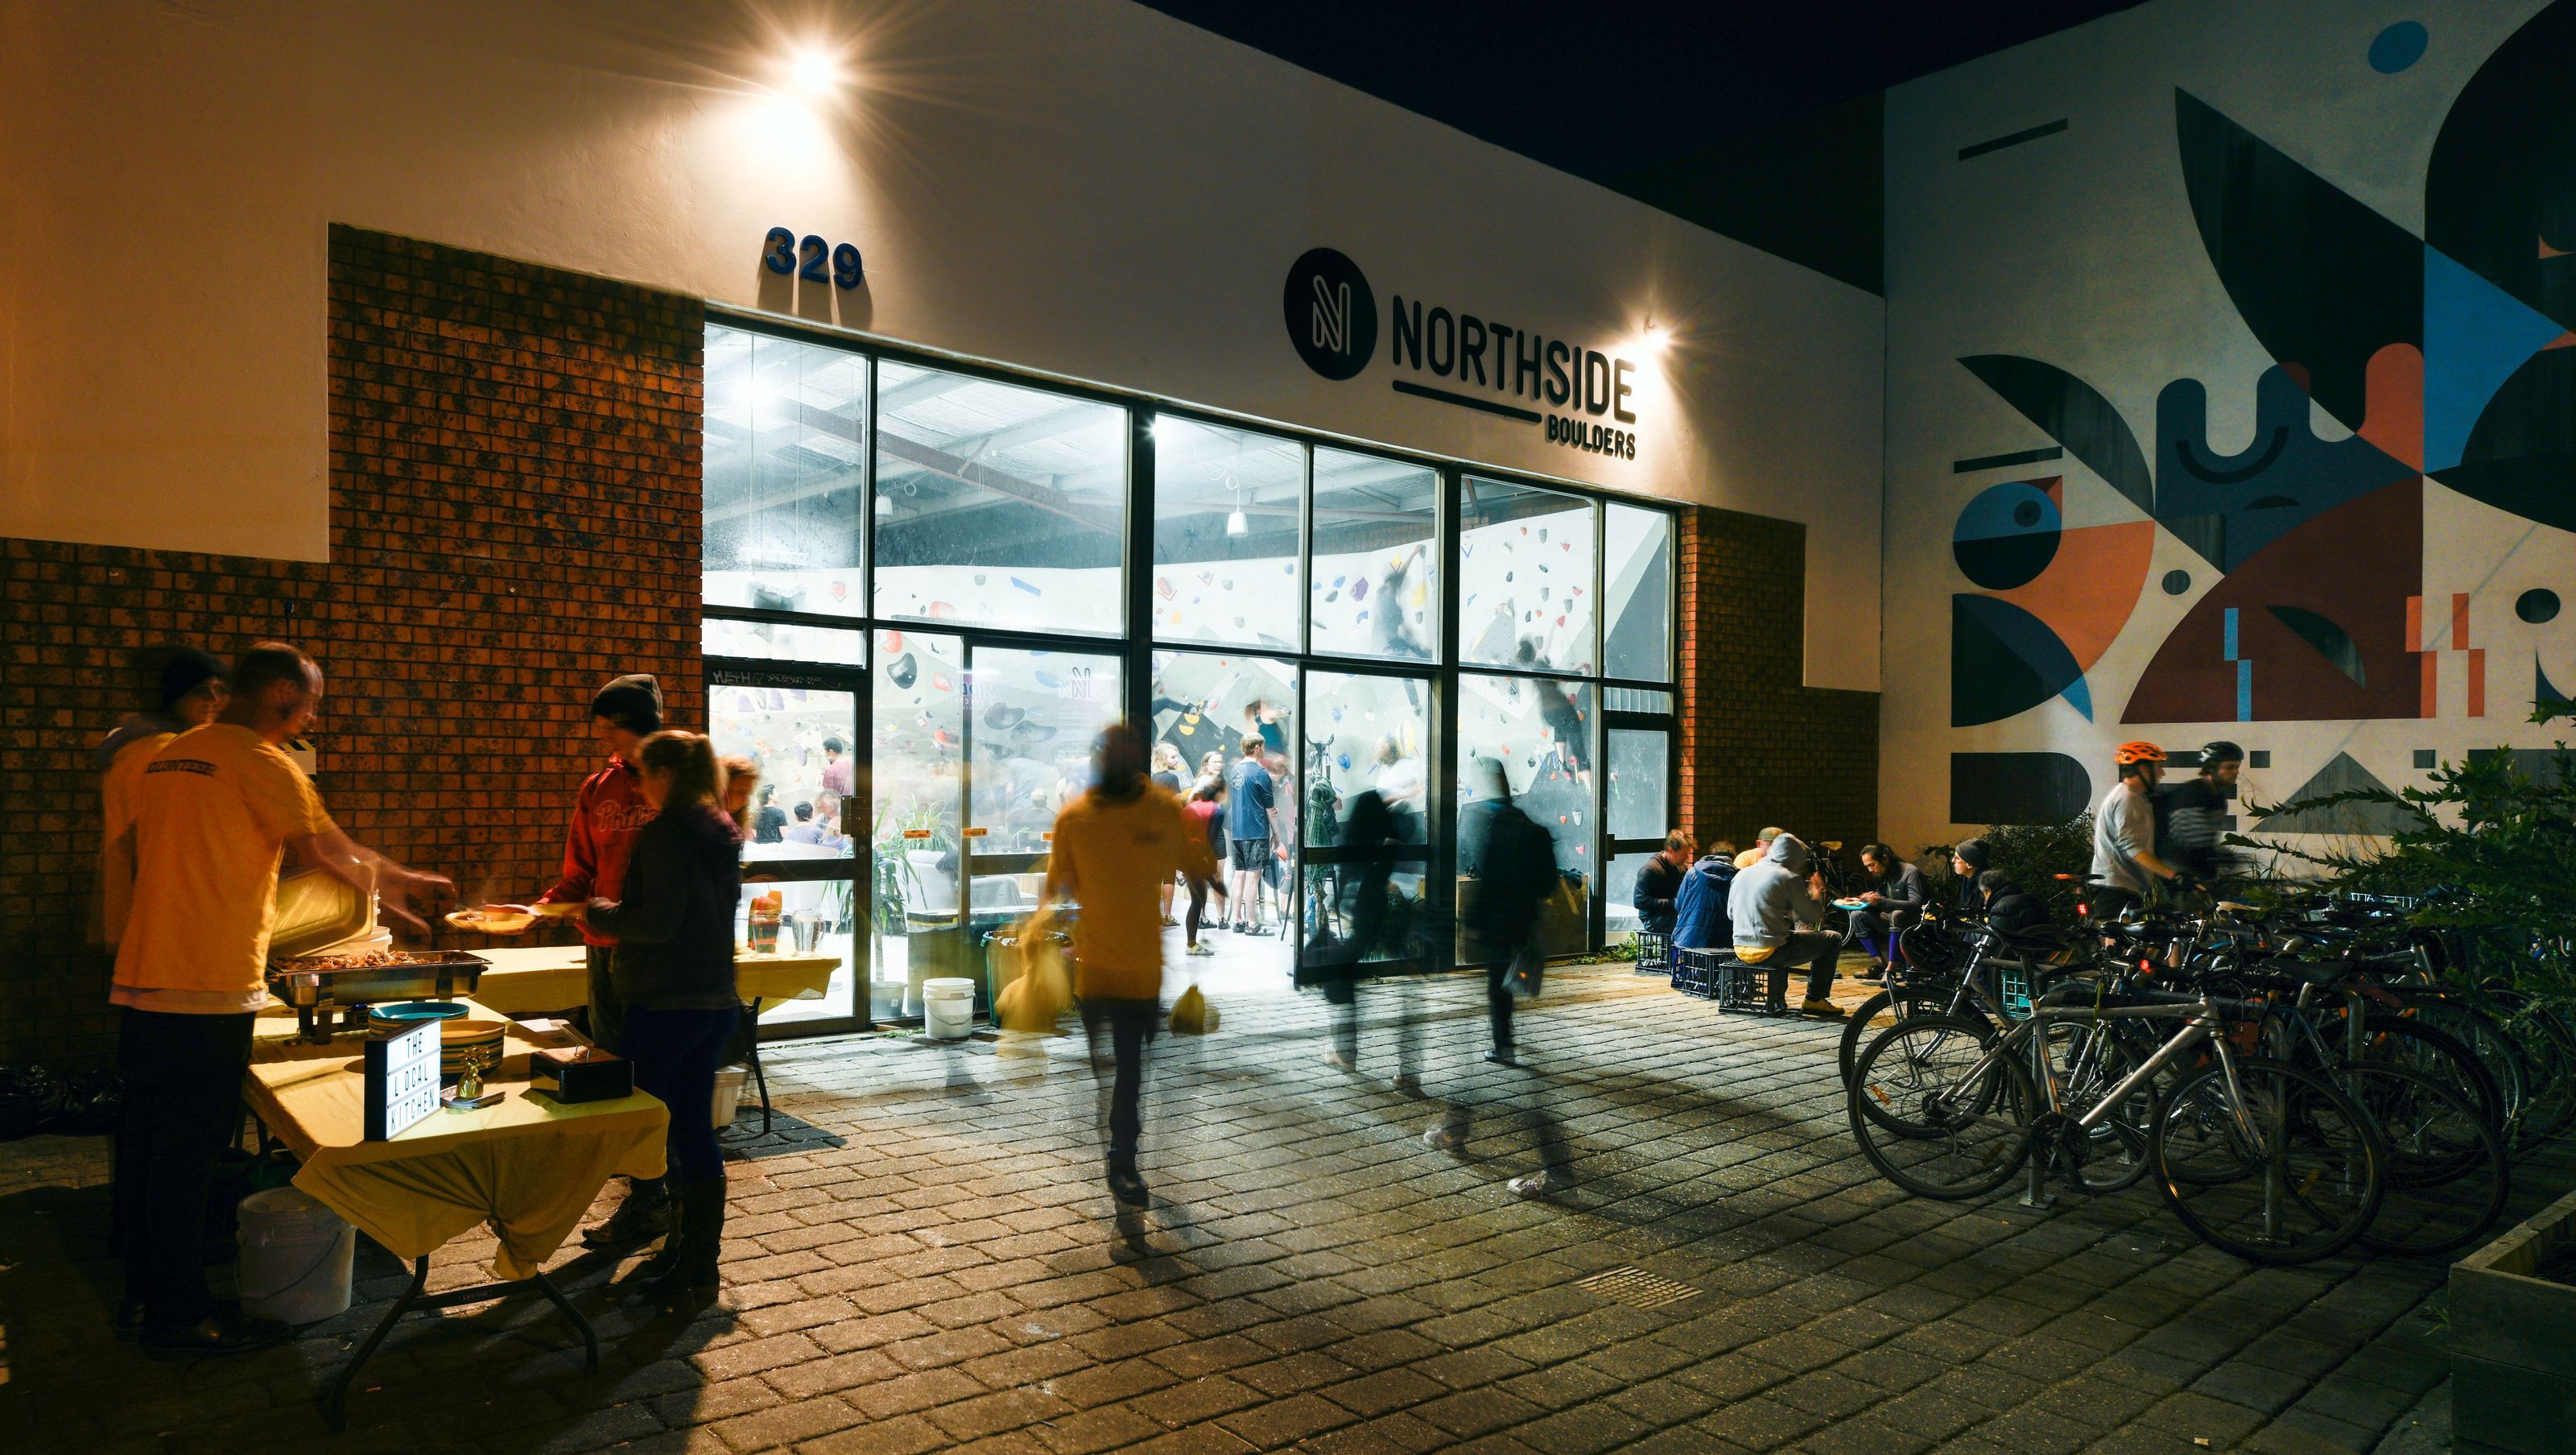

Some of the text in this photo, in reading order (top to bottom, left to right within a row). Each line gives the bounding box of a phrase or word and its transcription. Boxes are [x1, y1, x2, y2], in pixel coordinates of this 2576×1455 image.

[766, 226, 862, 289] 329
[1392, 295, 1637, 424] NORTHSIDE
[1547, 415, 1636, 461] BOULDERS
[407, 1032, 423, 1058] THE
[394, 1061, 428, 1097] LOCAL
[390, 1088, 435, 1132] KITCHEN
